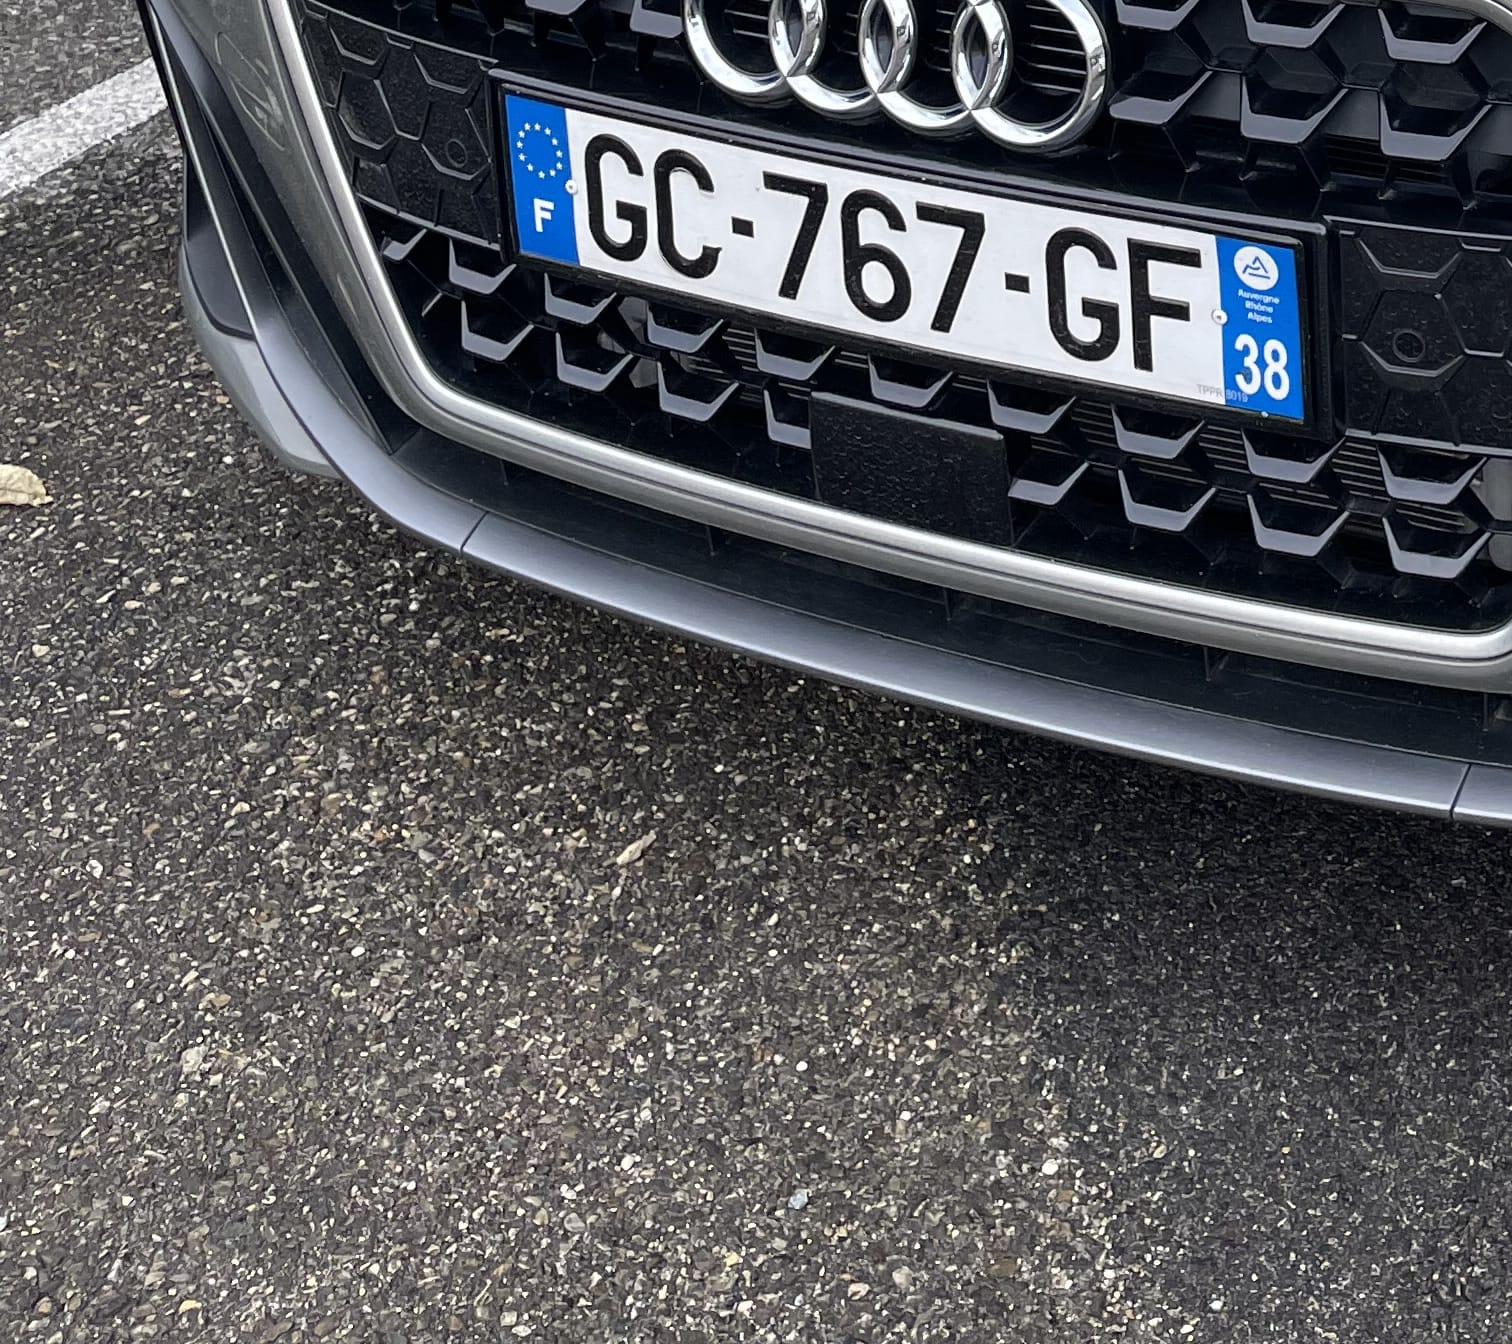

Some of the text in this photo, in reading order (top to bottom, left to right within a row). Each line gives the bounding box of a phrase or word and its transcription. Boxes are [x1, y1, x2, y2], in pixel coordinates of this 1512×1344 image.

[533, 198, 555, 232] F
[584, 132, 1202, 373] GC-767-GF
[1238, 288, 1280, 305] Auvergne
[1247, 311, 1273, 324] Alpes
[1234, 333, 1290, 401] 38
